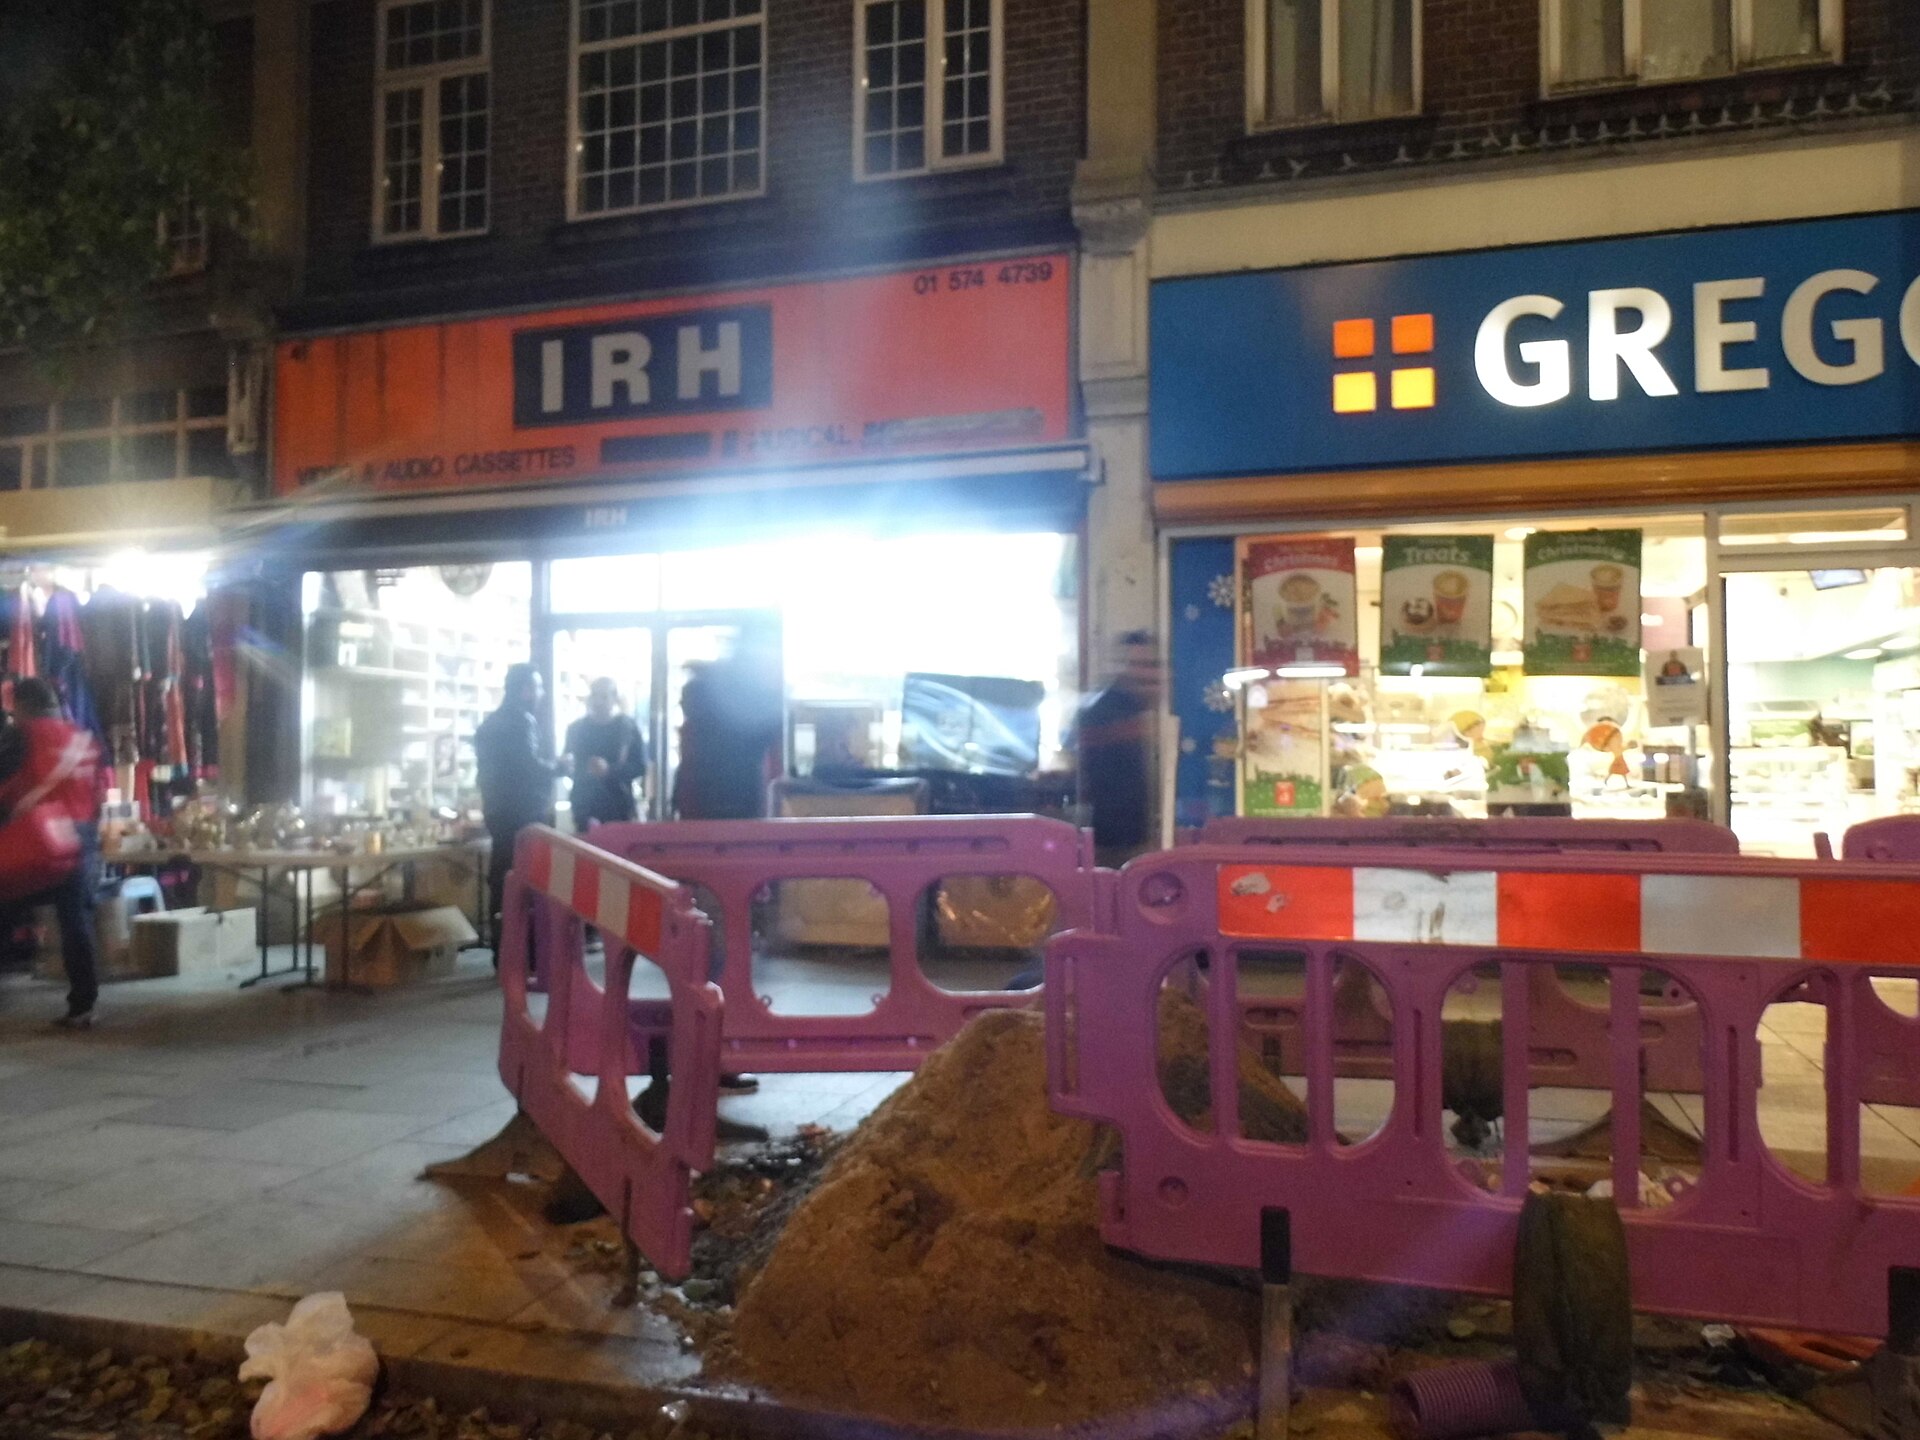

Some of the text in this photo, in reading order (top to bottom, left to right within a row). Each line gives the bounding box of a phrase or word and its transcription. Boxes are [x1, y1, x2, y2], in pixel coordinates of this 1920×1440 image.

[949, 269, 984, 290] 574
[1474, 268, 1920, 407] GREG
[541, 320, 741, 413] IRH
[454, 444, 576, 476] CASSETTES
[1402, 546, 1471, 563] Treats
